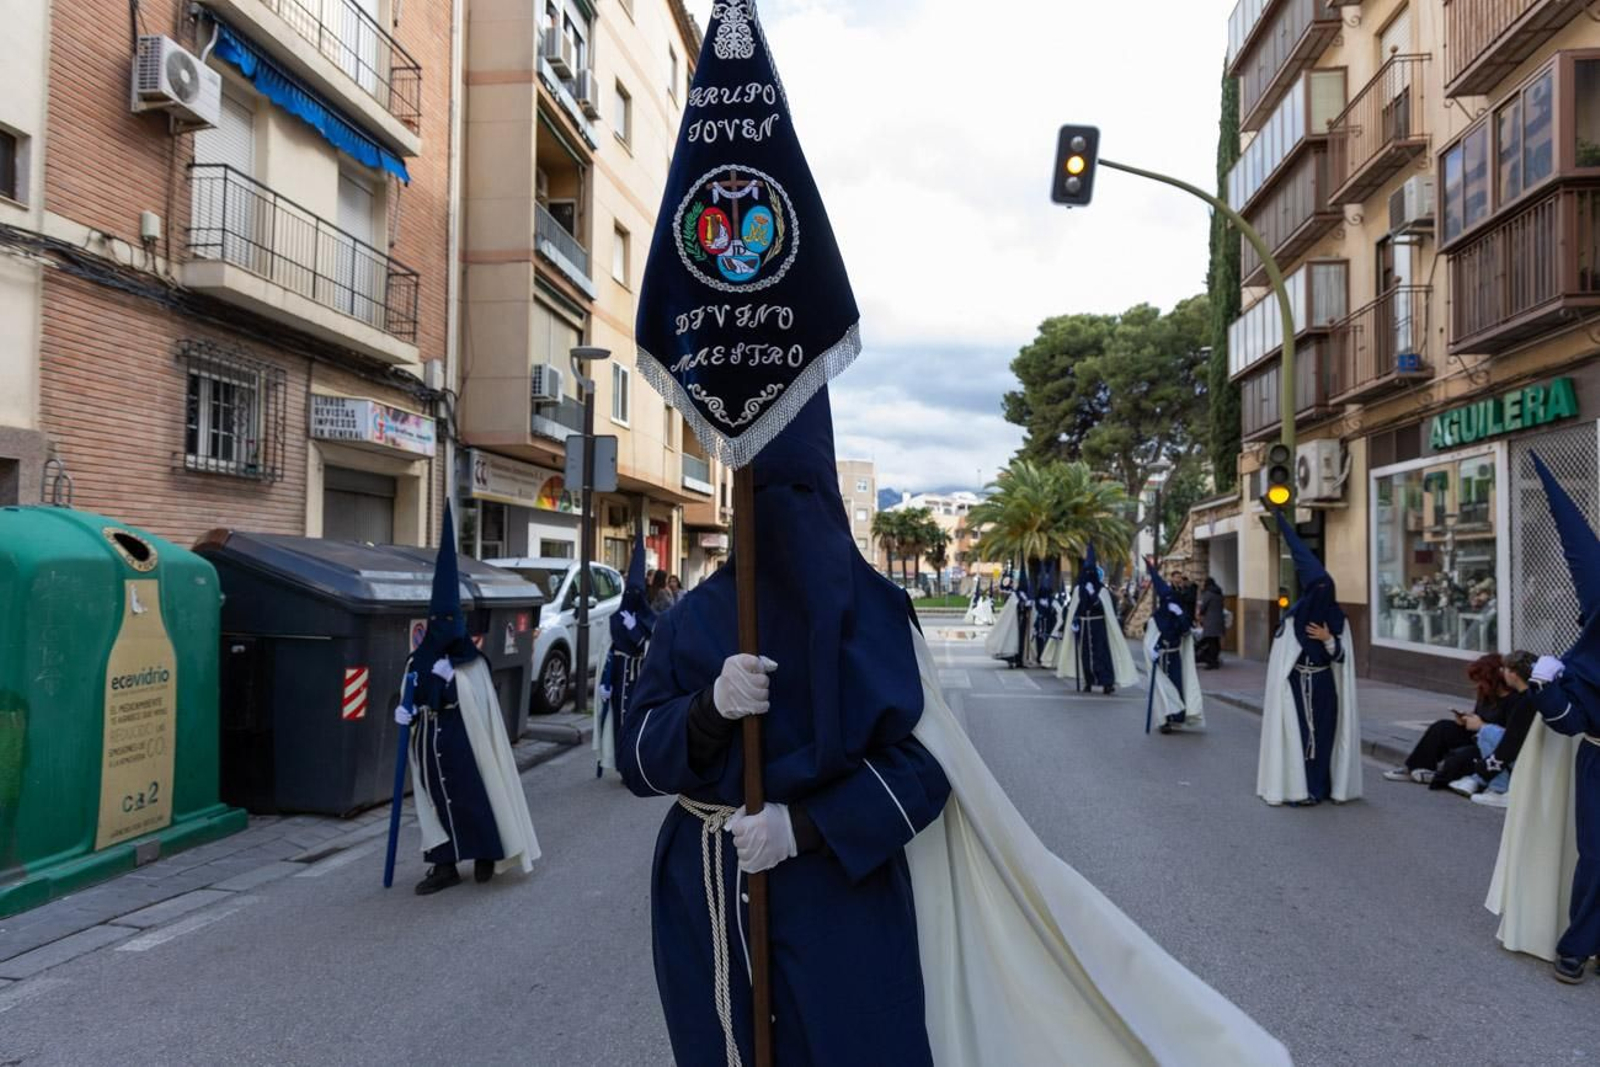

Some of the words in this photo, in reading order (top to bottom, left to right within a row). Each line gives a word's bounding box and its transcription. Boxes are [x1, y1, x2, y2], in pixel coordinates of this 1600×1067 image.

[689, 82, 776, 107] GRUPO
[688, 113, 779, 143] JOVEN
[675, 303, 794, 335] DIVINO
[670, 342, 803, 372] MAESTRO
[314, 397, 345, 407] LIBROS
[314, 407, 355, 418] REVISTAS
[1429, 376, 1578, 450] AGUILERA
[314, 418, 357, 429] IMPRESOS
[314, 428, 325, 437] EN
[328, 429, 363, 439] GENERAL
